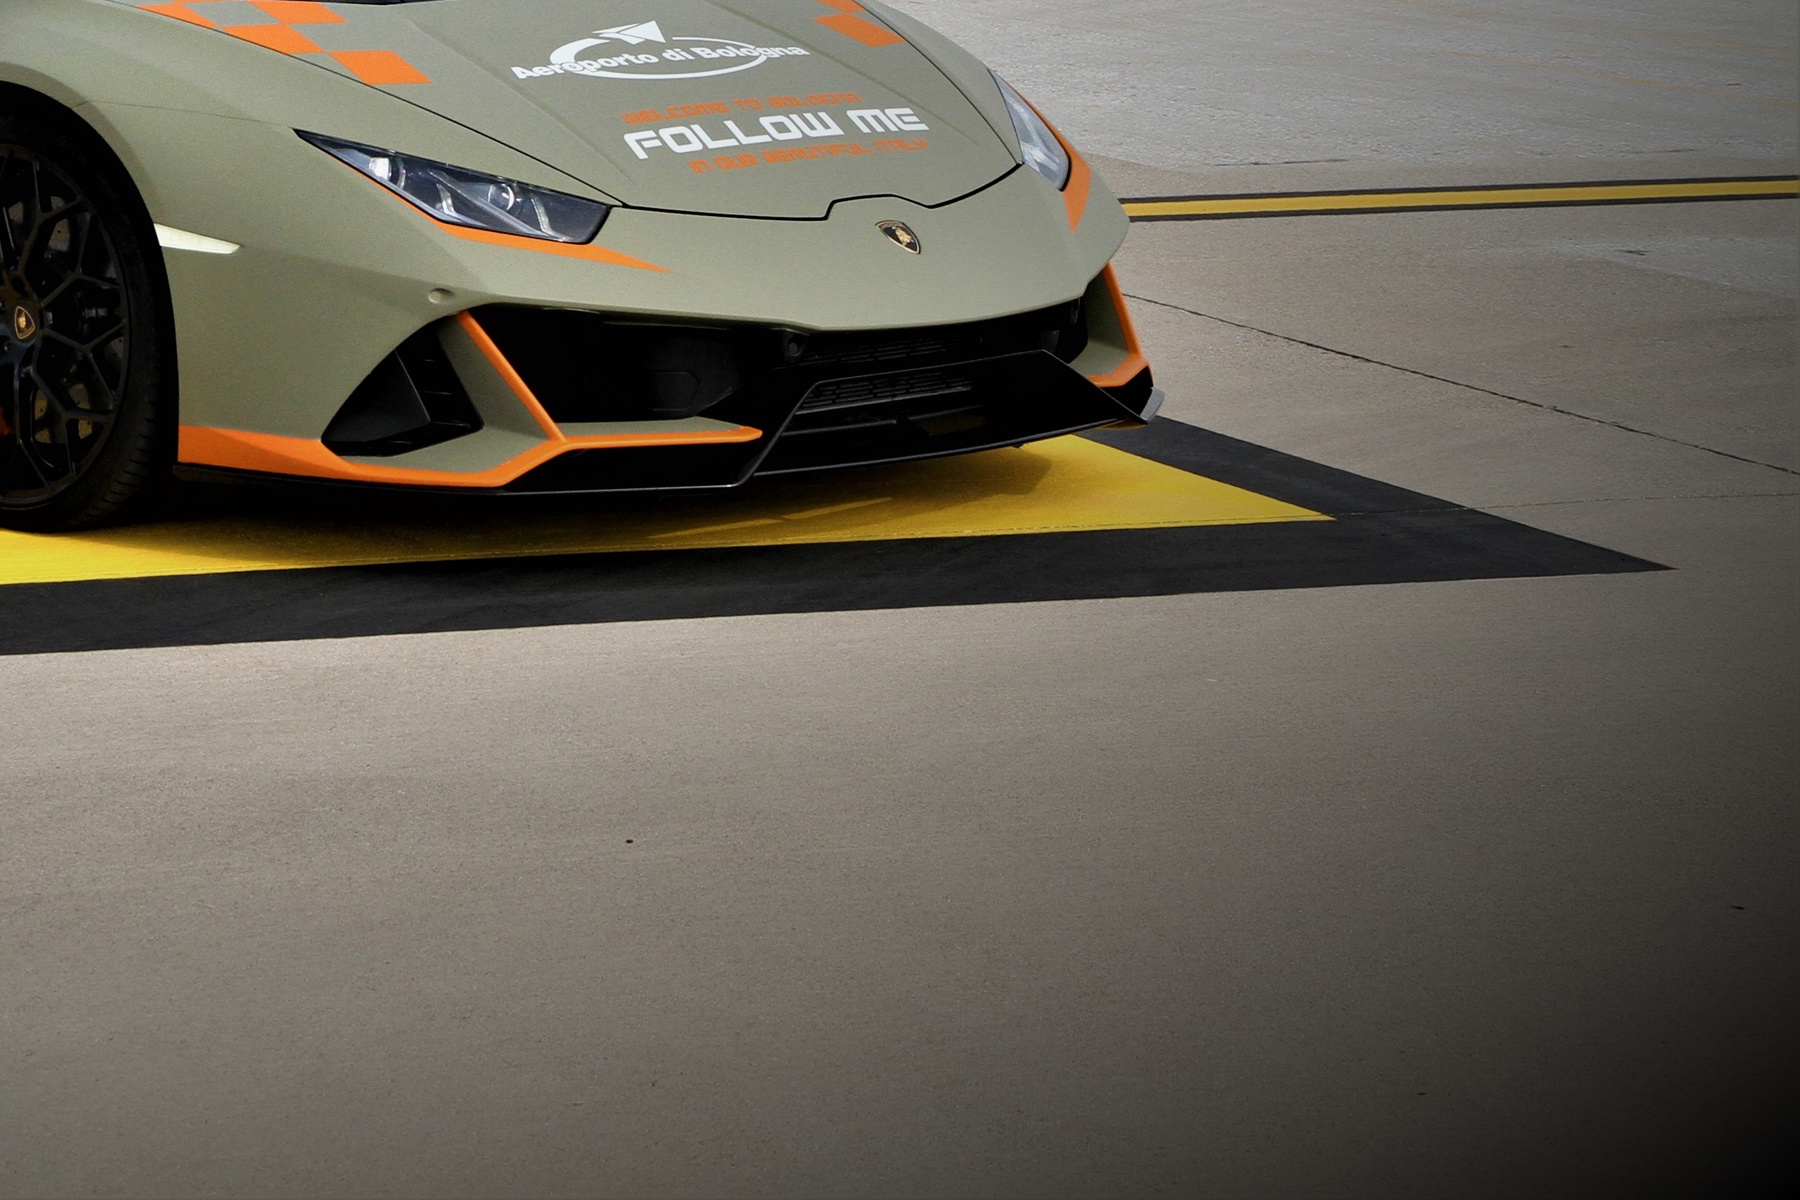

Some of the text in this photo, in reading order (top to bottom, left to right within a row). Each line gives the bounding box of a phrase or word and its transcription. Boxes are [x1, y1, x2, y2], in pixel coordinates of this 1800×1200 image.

[510, 44, 811, 80] Aeroporto di Bologna
[620, 100, 732, 125] WELCOME
[730, 98, 765, 111] TO
[623, 107, 930, 160] FOLLOW ME
[688, 158, 715, 175] IN
